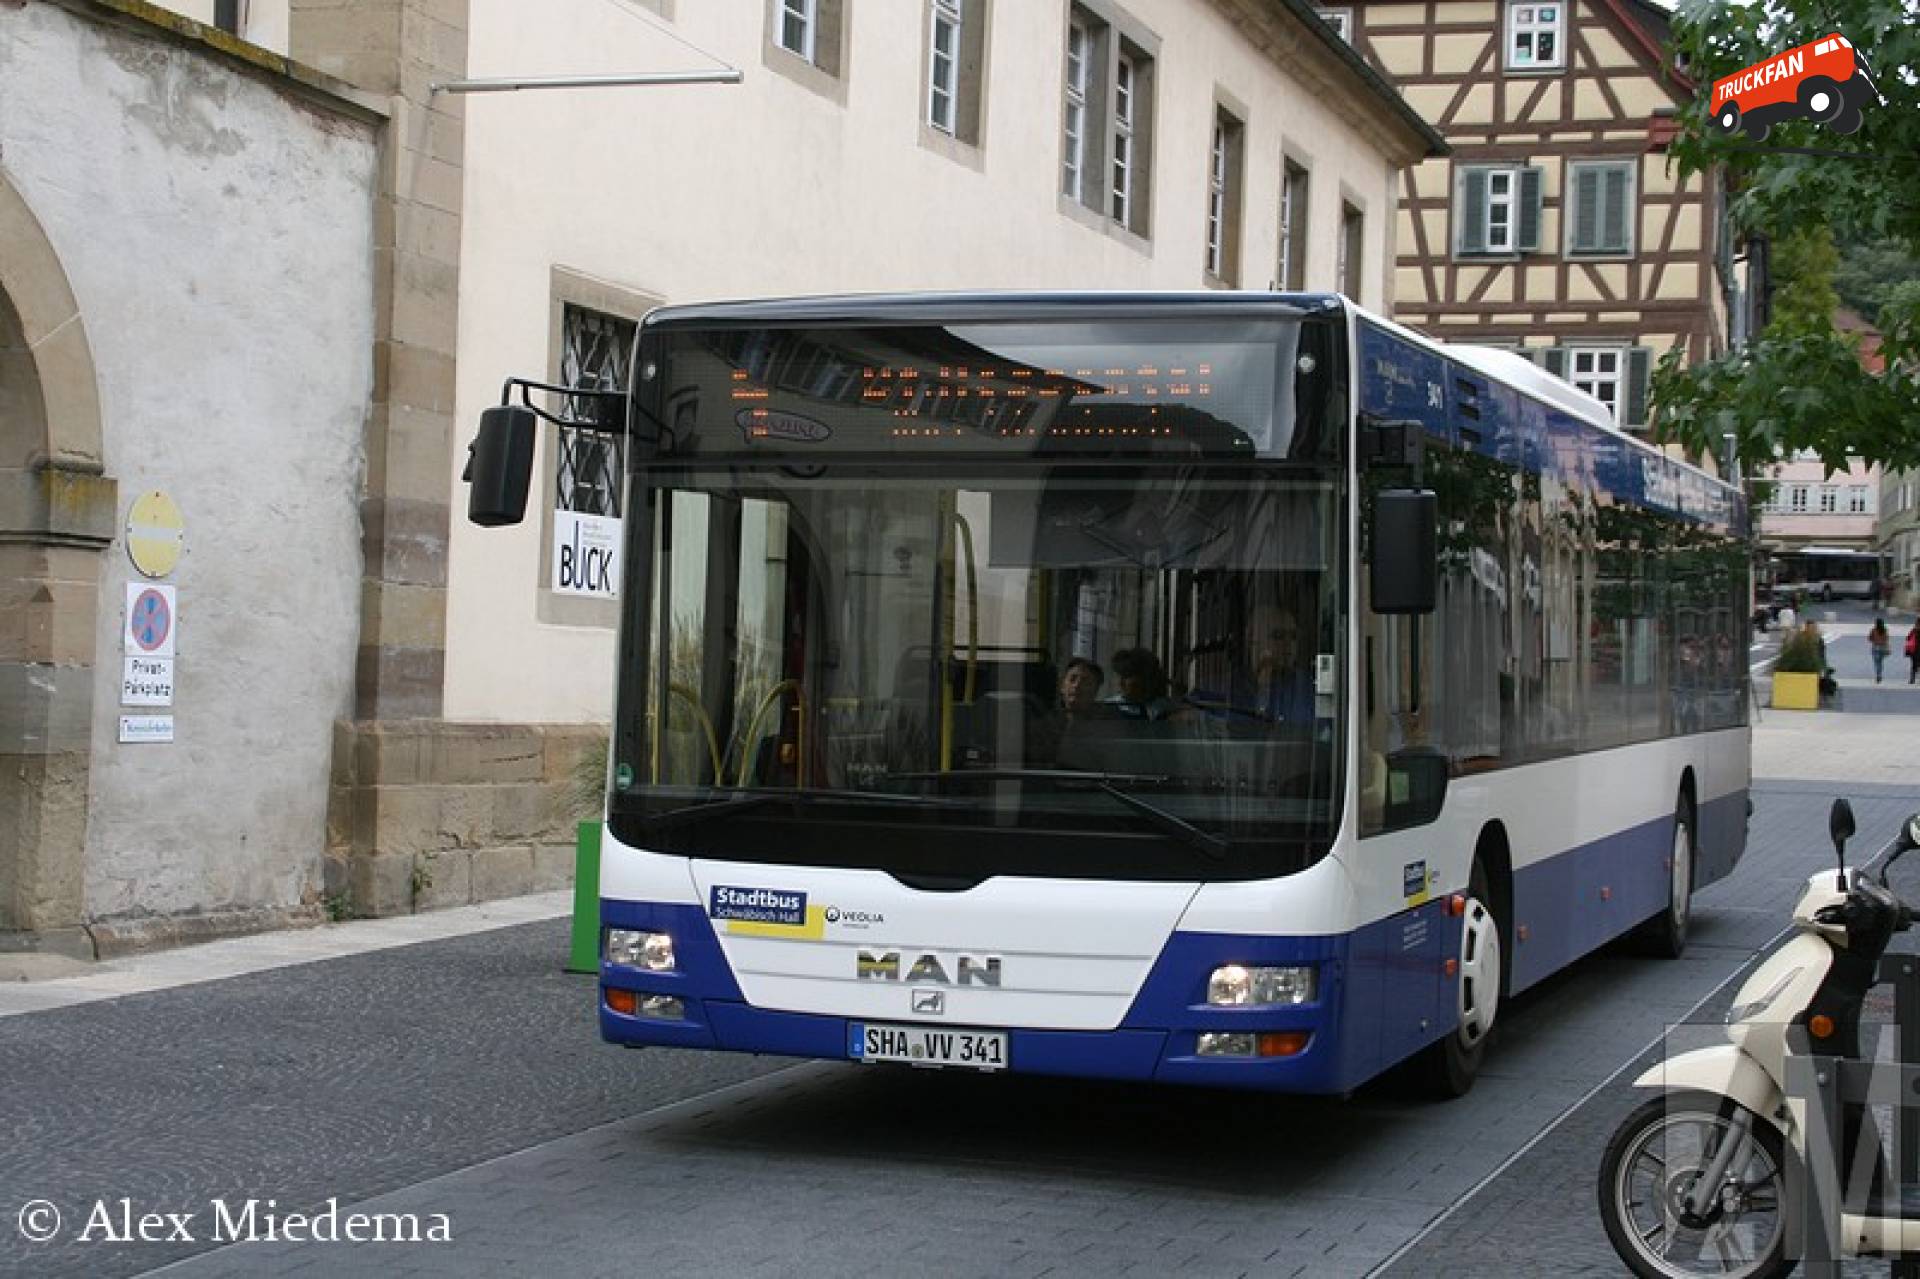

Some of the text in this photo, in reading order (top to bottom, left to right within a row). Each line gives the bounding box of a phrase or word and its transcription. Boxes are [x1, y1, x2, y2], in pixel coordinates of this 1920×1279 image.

[716, 887, 801, 910] Stadtbus
[779, 910, 801, 922] Hall
[842, 910, 884, 923] VEOLIA
[857, 951, 1001, 986] MAN
[866, 1029, 1002, 1064] SHA VV 341
